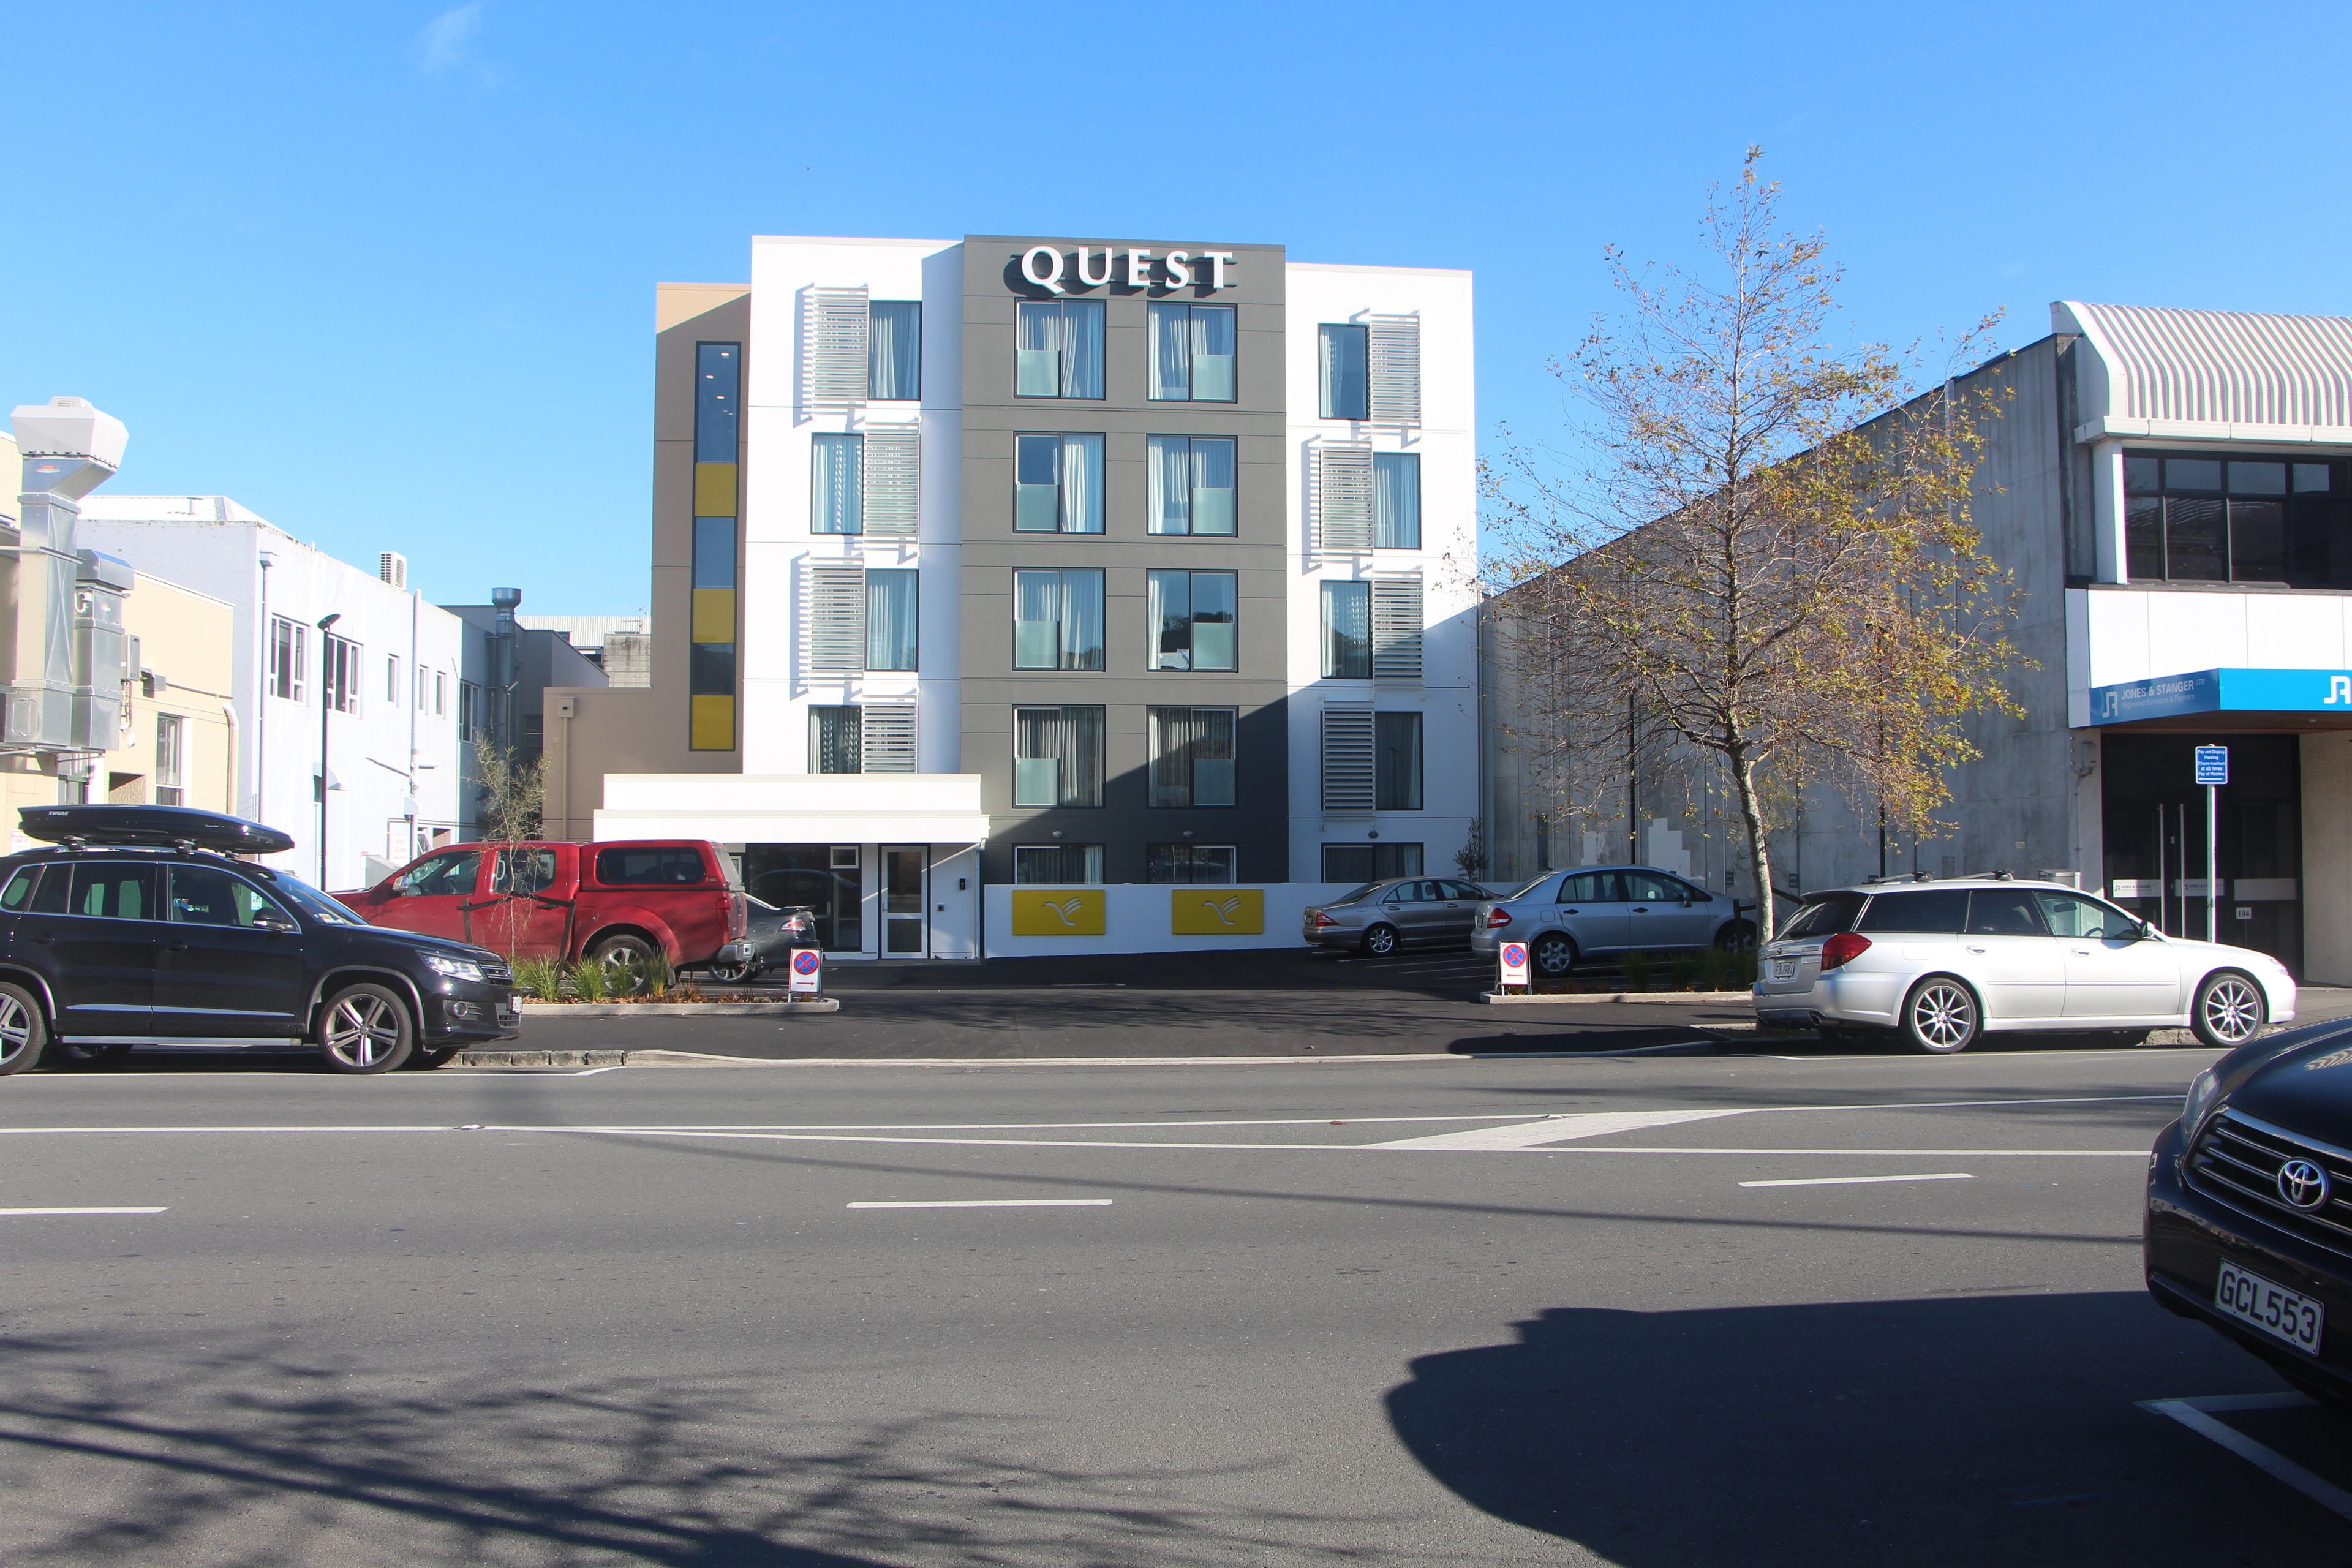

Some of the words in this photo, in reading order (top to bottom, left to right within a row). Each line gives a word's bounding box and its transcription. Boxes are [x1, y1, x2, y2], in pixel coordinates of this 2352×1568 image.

[1021, 246, 1233, 295] QUEST
[2121, 687, 2146, 700] JONES
[2148, 686, 2155, 696] &
[2156, 680, 2194, 695] STANGER
[2220, 1270, 2316, 1343] GCL553
